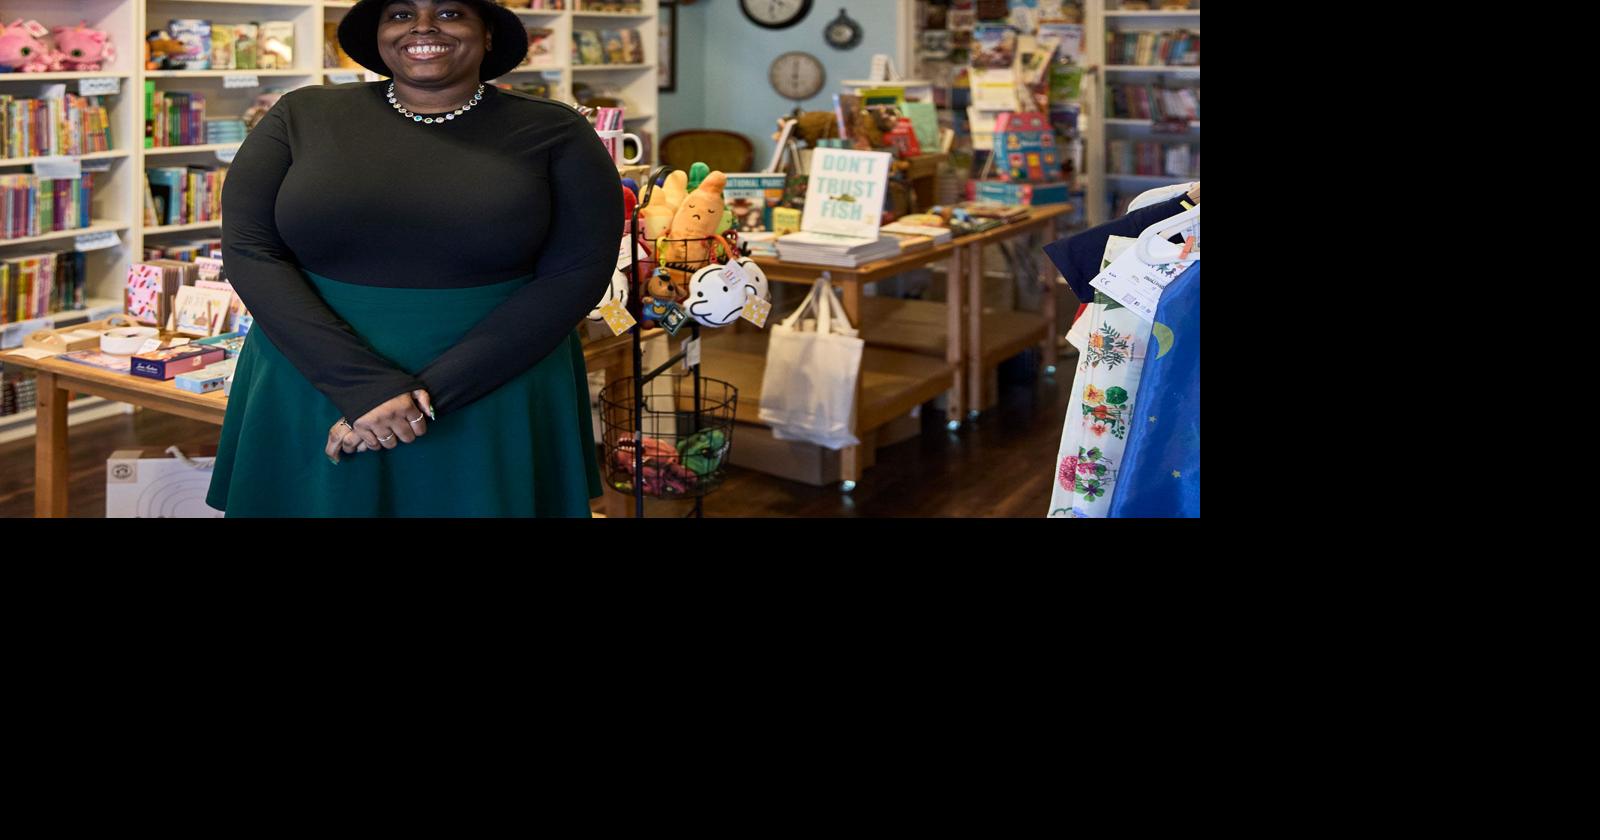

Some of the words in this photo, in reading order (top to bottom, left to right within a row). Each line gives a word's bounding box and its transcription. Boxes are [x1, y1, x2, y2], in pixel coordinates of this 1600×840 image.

[823, 155, 876, 175] DON'T
[816, 176, 876, 198] TRUST
[820, 201, 863, 220] FISH
